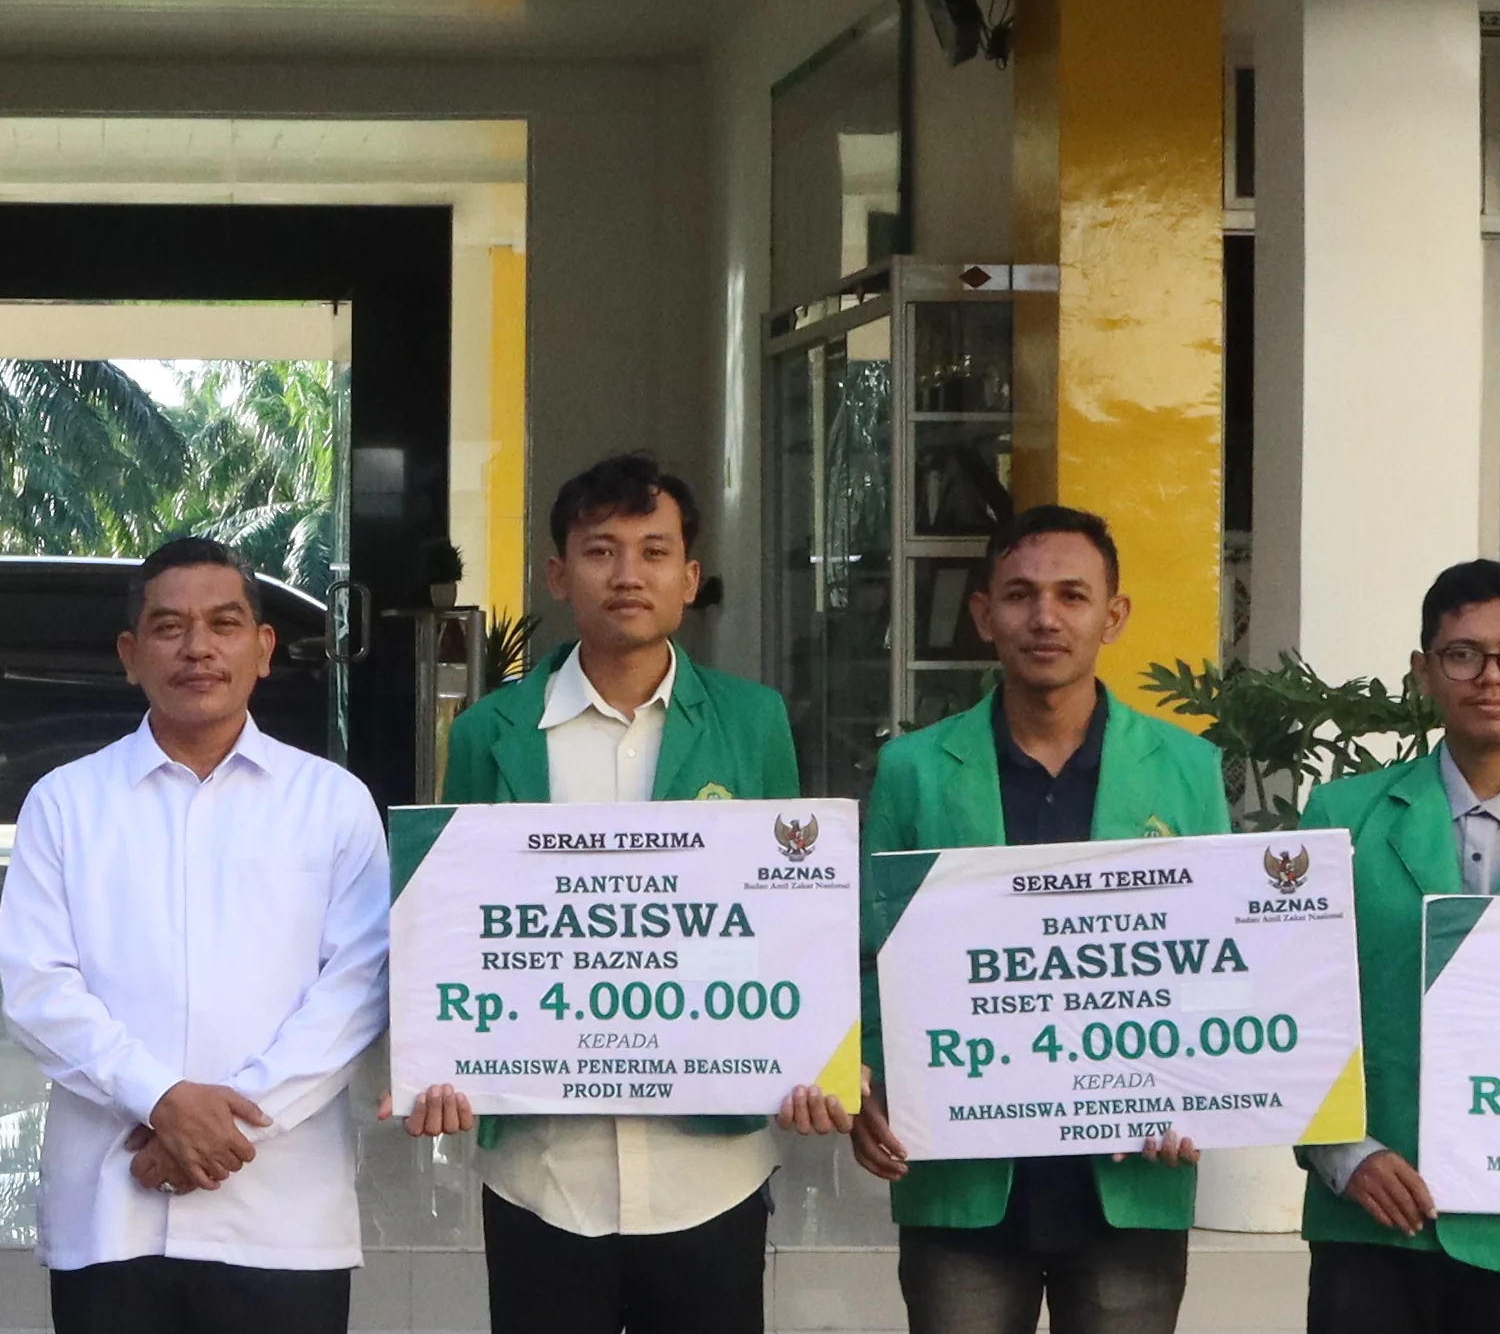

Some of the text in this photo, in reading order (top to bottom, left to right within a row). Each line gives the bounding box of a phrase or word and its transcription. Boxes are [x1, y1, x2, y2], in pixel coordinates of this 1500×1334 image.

[528, 833, 705, 849] SERAH TERIMA
[758, 867, 835, 880] BAZNAS
[1012, 868, 1193, 892] SERAH TERIMA
[556, 876, 678, 893] BANTUAN
[1249, 897, 1329, 914] BAZNAS
[480, 903, 755, 938] BEASISWA
[1042, 913, 1167, 935] BANTUAN
[482, 951, 678, 969] RISET BAZNAS
[967, 937, 1248, 983] BEASISWA
[436, 981, 800, 1032] Rp. 4.000.000
[971, 989, 1171, 1015] RISET BAZNAS
[578, 1034, 658, 1048] KEPADA
[926, 1014, 1297, 1078] Rp. 4.000.000
[456, 1059, 781, 1074] MAHASISWA PENERIMA BEASISWA
[563, 1083, 673, 1098] PRODI MZW
[1072, 1073, 1155, 1090] KEPADA
[949, 1093, 1282, 1120] MAHASISWA PENERIMA BEASISWA
[1060, 1122, 1172, 1140] PRODI MZW
